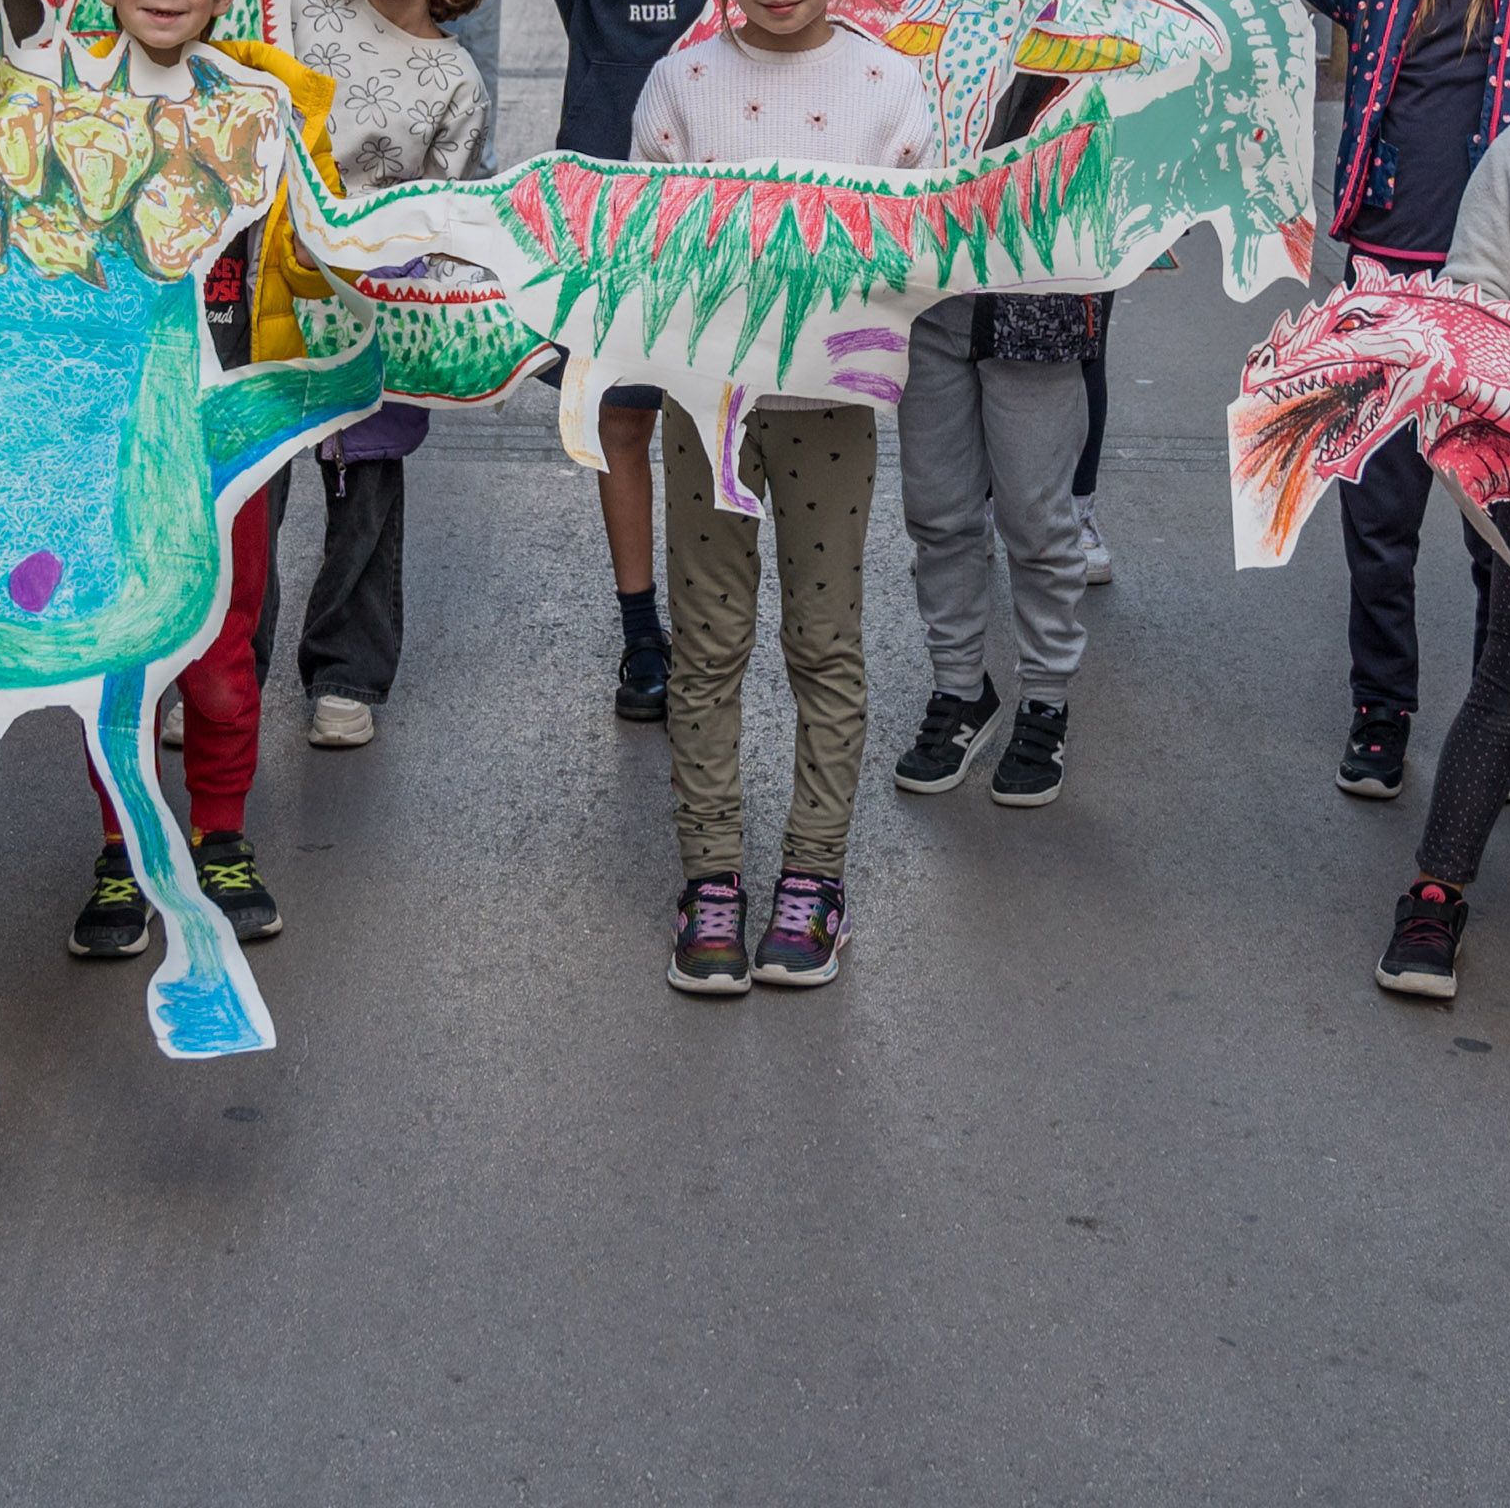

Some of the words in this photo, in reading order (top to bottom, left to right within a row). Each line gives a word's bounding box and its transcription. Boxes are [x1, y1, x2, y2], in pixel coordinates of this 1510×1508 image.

[209, 256, 244, 279] KEY
[204, 279, 241, 301] USE
[206, 305, 234, 323] ends
